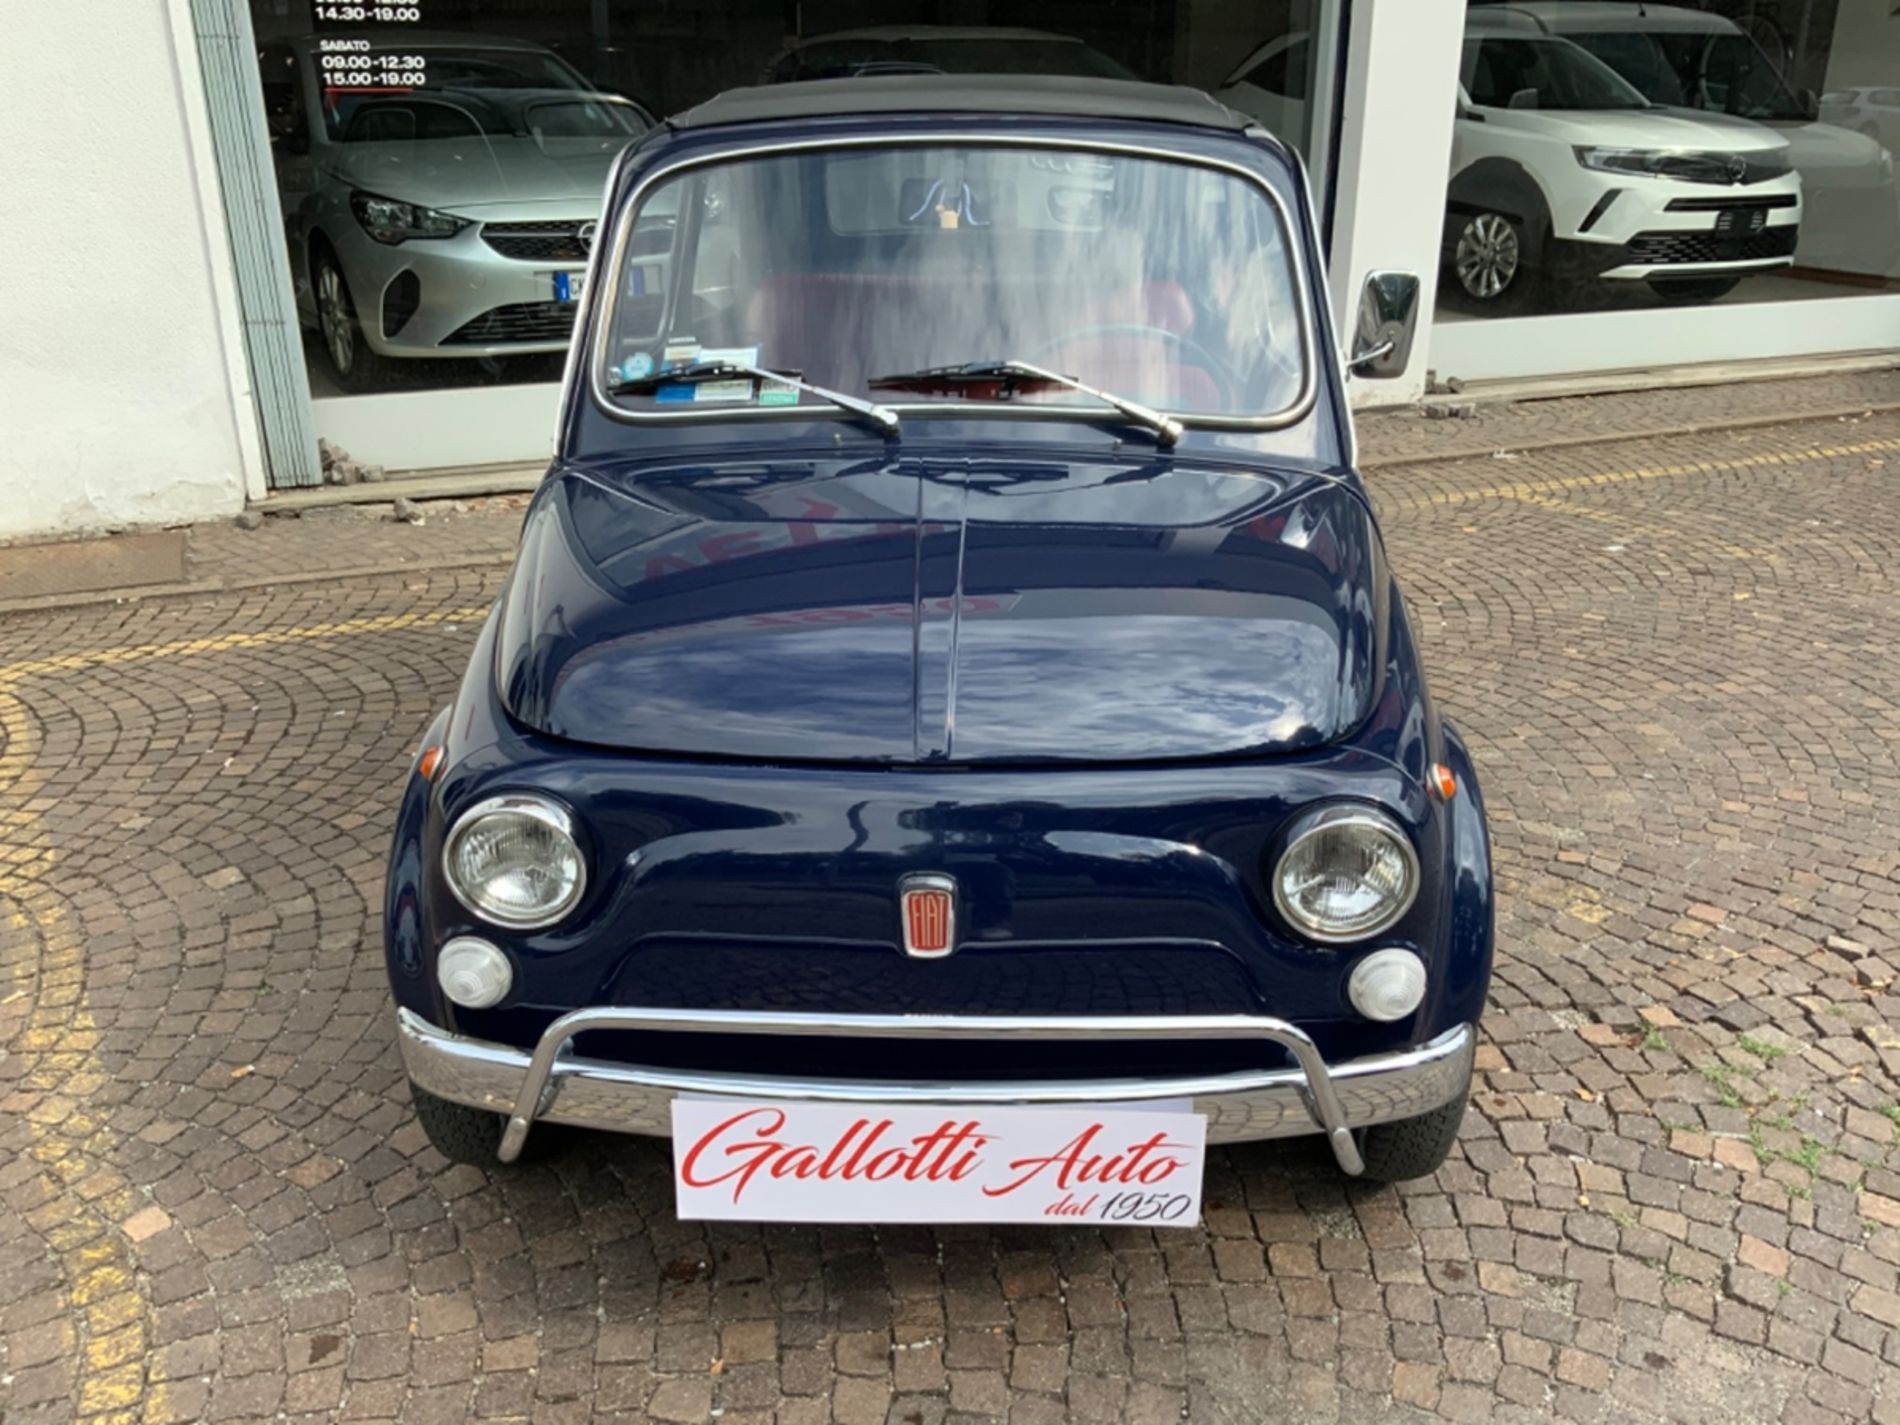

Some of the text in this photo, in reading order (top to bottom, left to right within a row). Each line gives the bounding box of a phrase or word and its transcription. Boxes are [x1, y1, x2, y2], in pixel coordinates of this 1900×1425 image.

[320, 39, 370, 51] SABATO
[321, 55, 425, 69] 09.00-12.30
[323, 71, 426, 85] 15.00-19.00
[912, 894, 946, 948] FIAT
[681, 1107, 1196, 1204] Gallotti Auto
[1044, 1192, 1192, 1220] dal 1950
